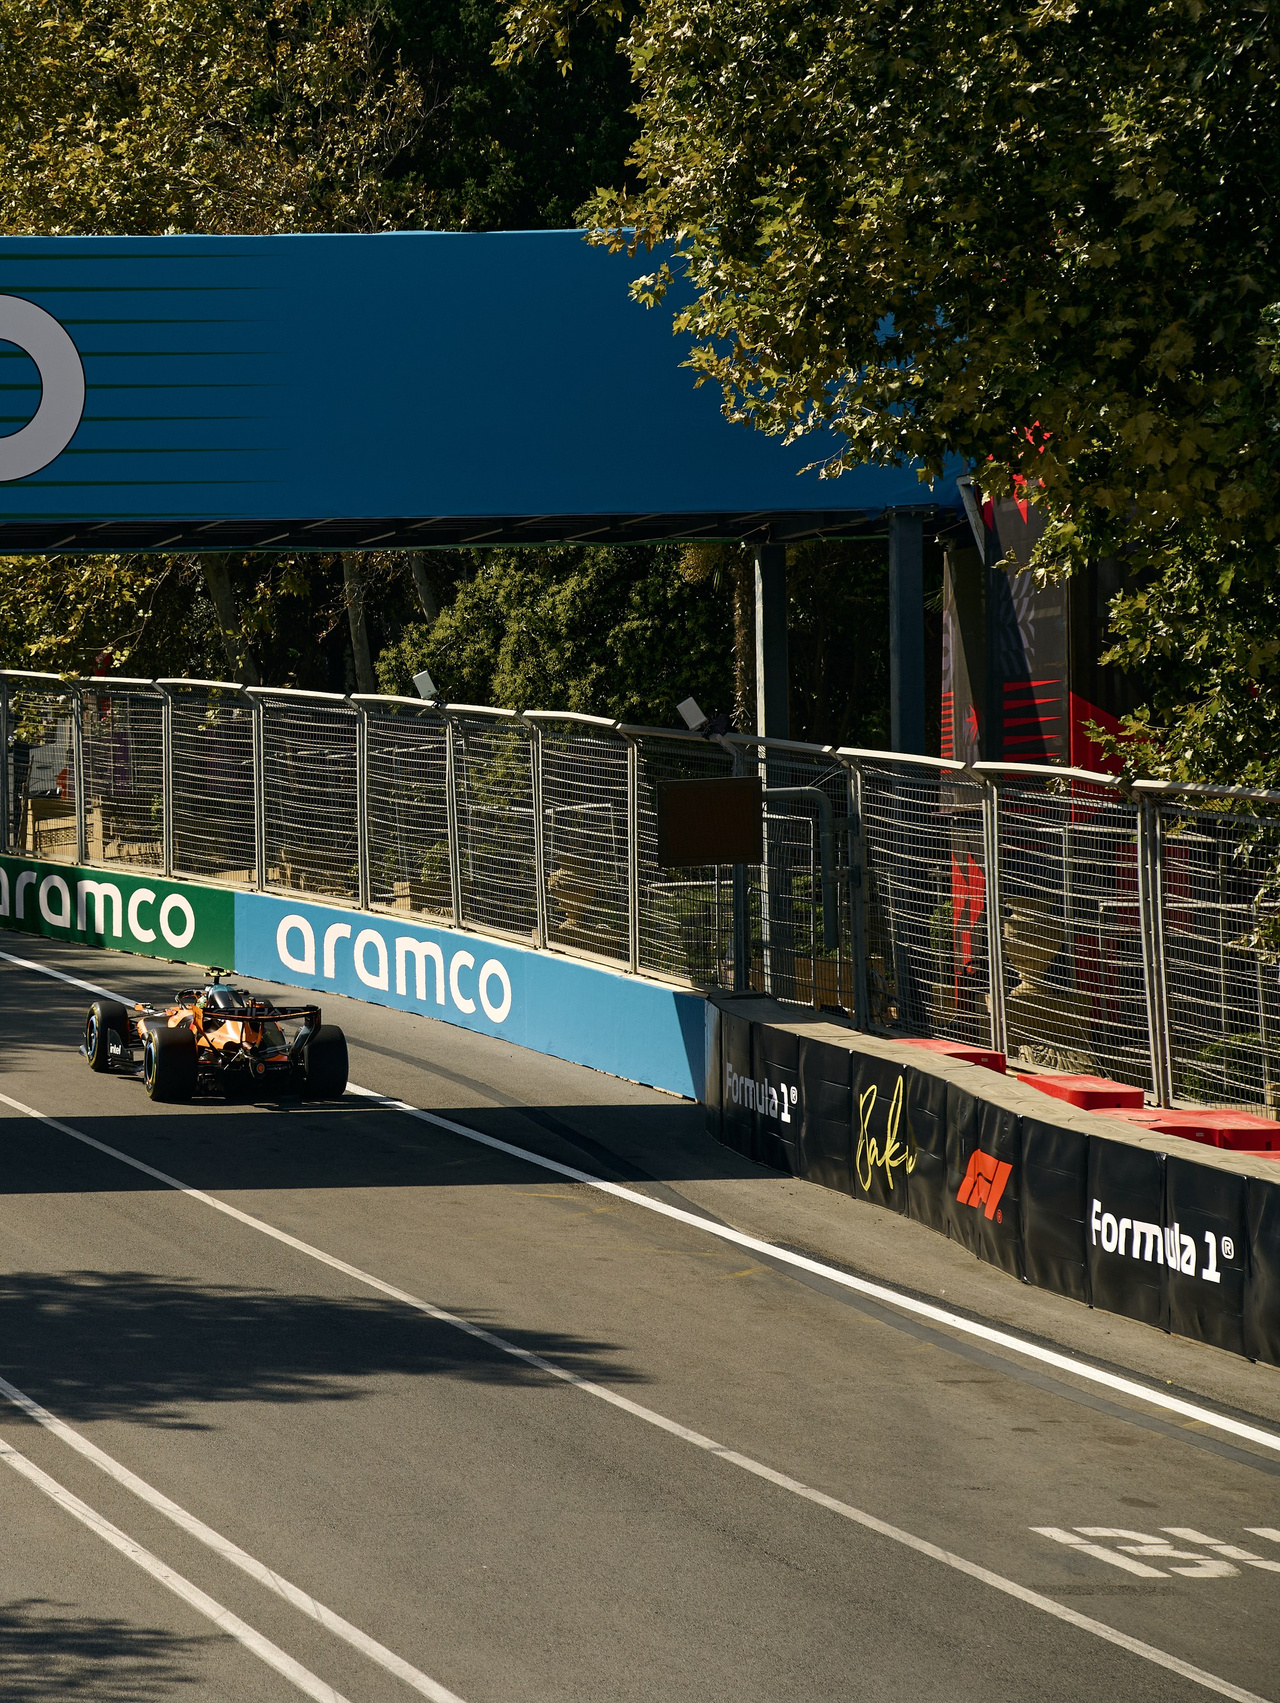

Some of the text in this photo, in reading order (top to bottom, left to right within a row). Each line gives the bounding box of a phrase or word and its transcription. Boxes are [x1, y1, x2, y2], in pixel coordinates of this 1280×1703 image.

[277, 914, 512, 1024] aramco
[110, 1042, 122, 1055] intel
[726, 1062, 778, 1119] Formula
[1091, 1198, 1197, 1277] Formula
